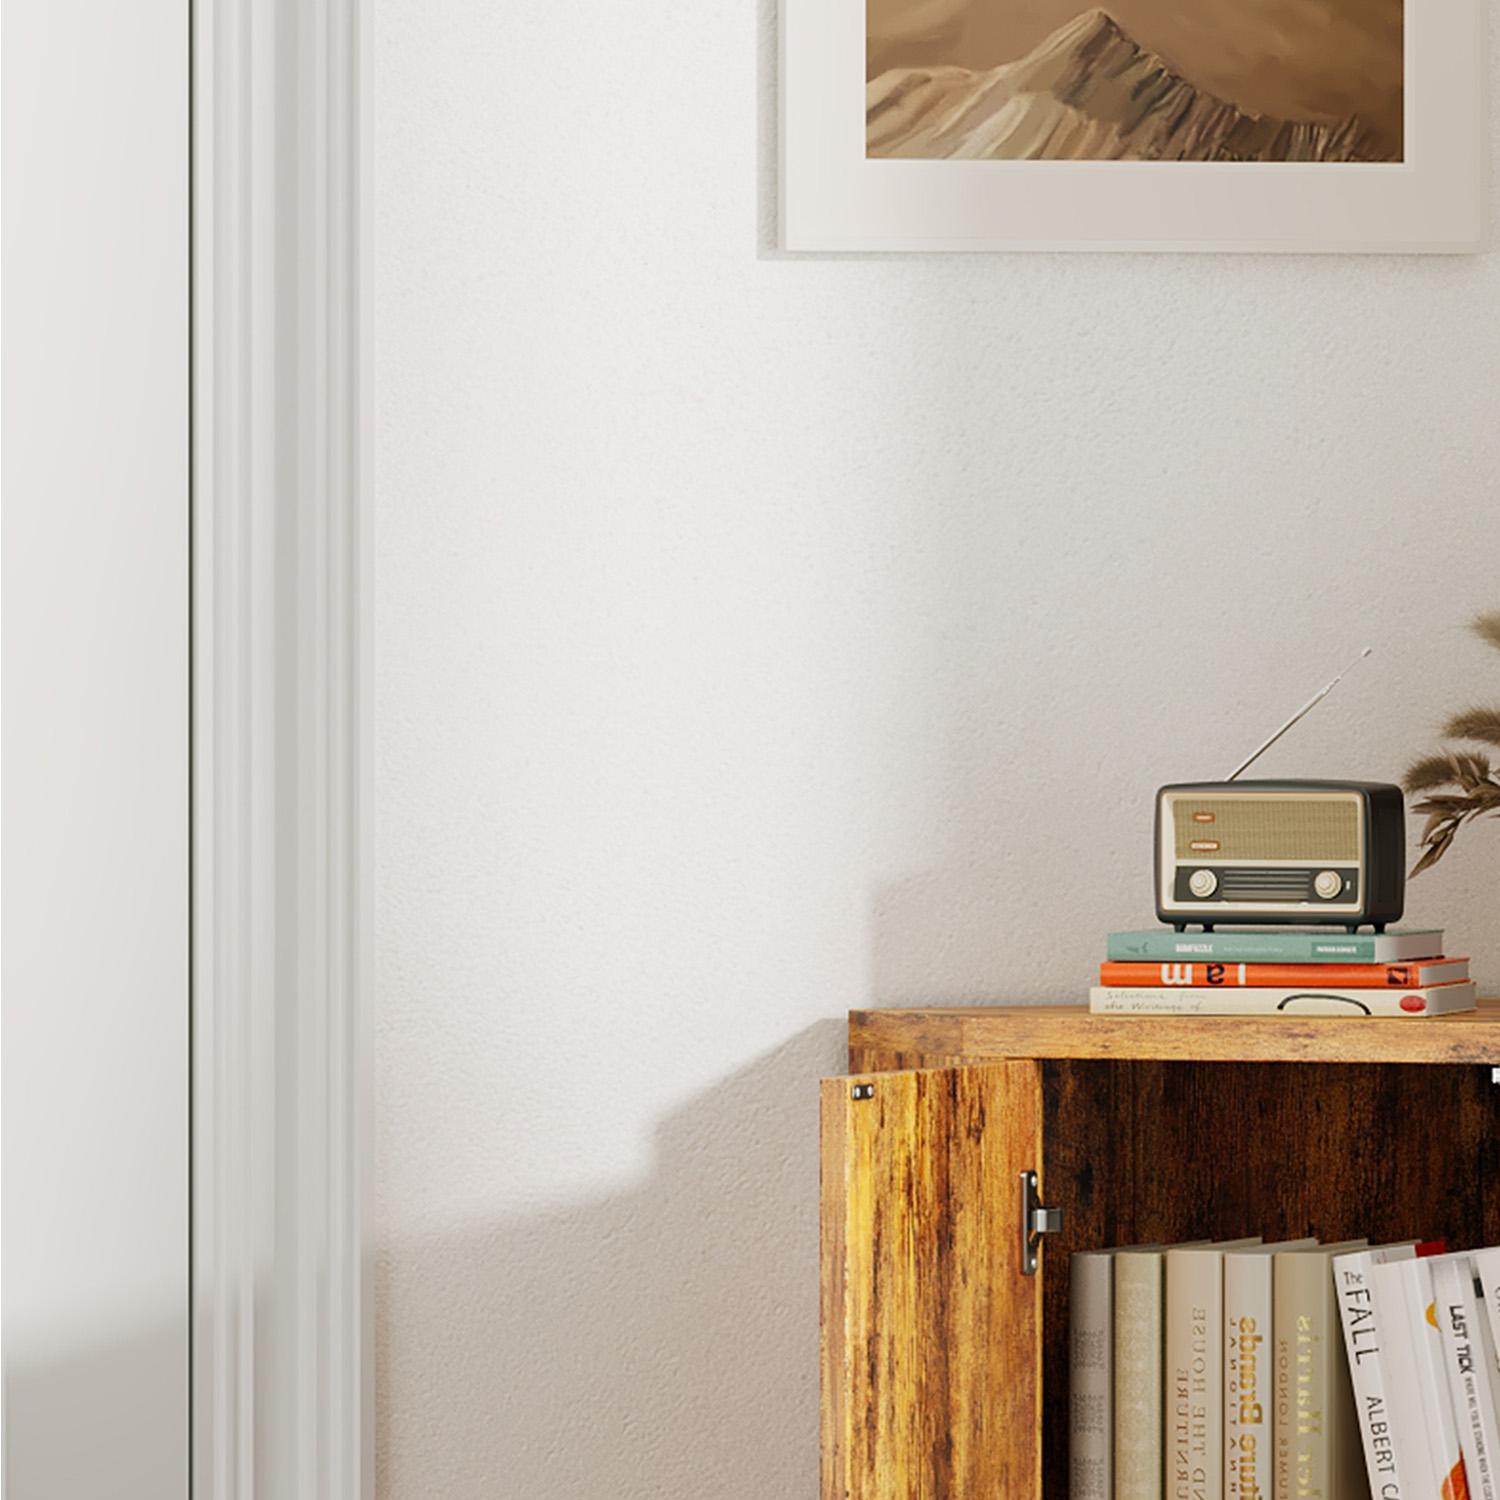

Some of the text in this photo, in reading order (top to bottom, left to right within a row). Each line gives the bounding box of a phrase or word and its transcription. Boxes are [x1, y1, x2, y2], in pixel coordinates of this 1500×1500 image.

[1345, 1288, 1380, 1366] FALL
[1449, 1305, 1468, 1339] LAST
[1456, 1343, 1476, 1374] TICK
[1366, 1396, 1396, 1474] ALBERT
